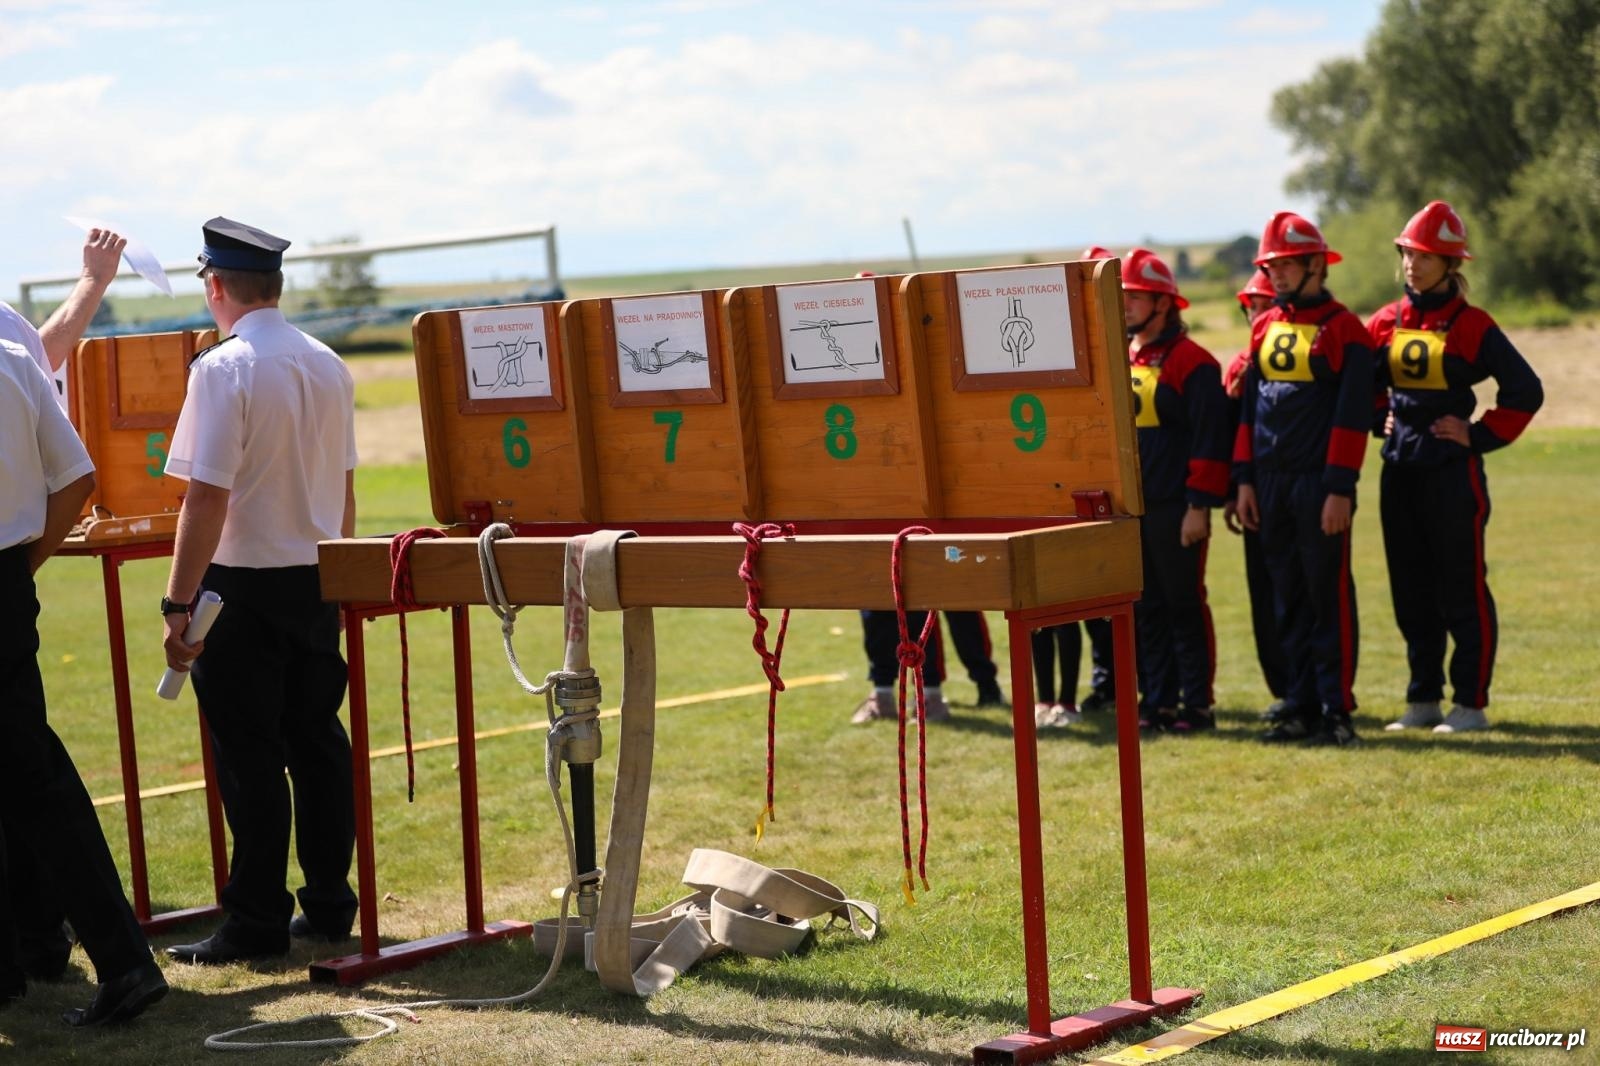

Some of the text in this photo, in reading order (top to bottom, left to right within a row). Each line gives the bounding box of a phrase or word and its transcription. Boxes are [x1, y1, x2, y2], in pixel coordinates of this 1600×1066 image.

[823, 297, 865, 309] CIESIELSKI
[1027, 284, 1065, 296] (TKACKI)
[643, 312, 654, 323] NA
[1268, 333, 1297, 372] 8
[1401, 339, 1429, 380] 9
[502, 418, 532, 468] 6
[653, 411, 684, 463] 7
[824, 404, 857, 460] 8
[1010, 394, 1047, 452] 9
[146, 432, 167, 478] 5
